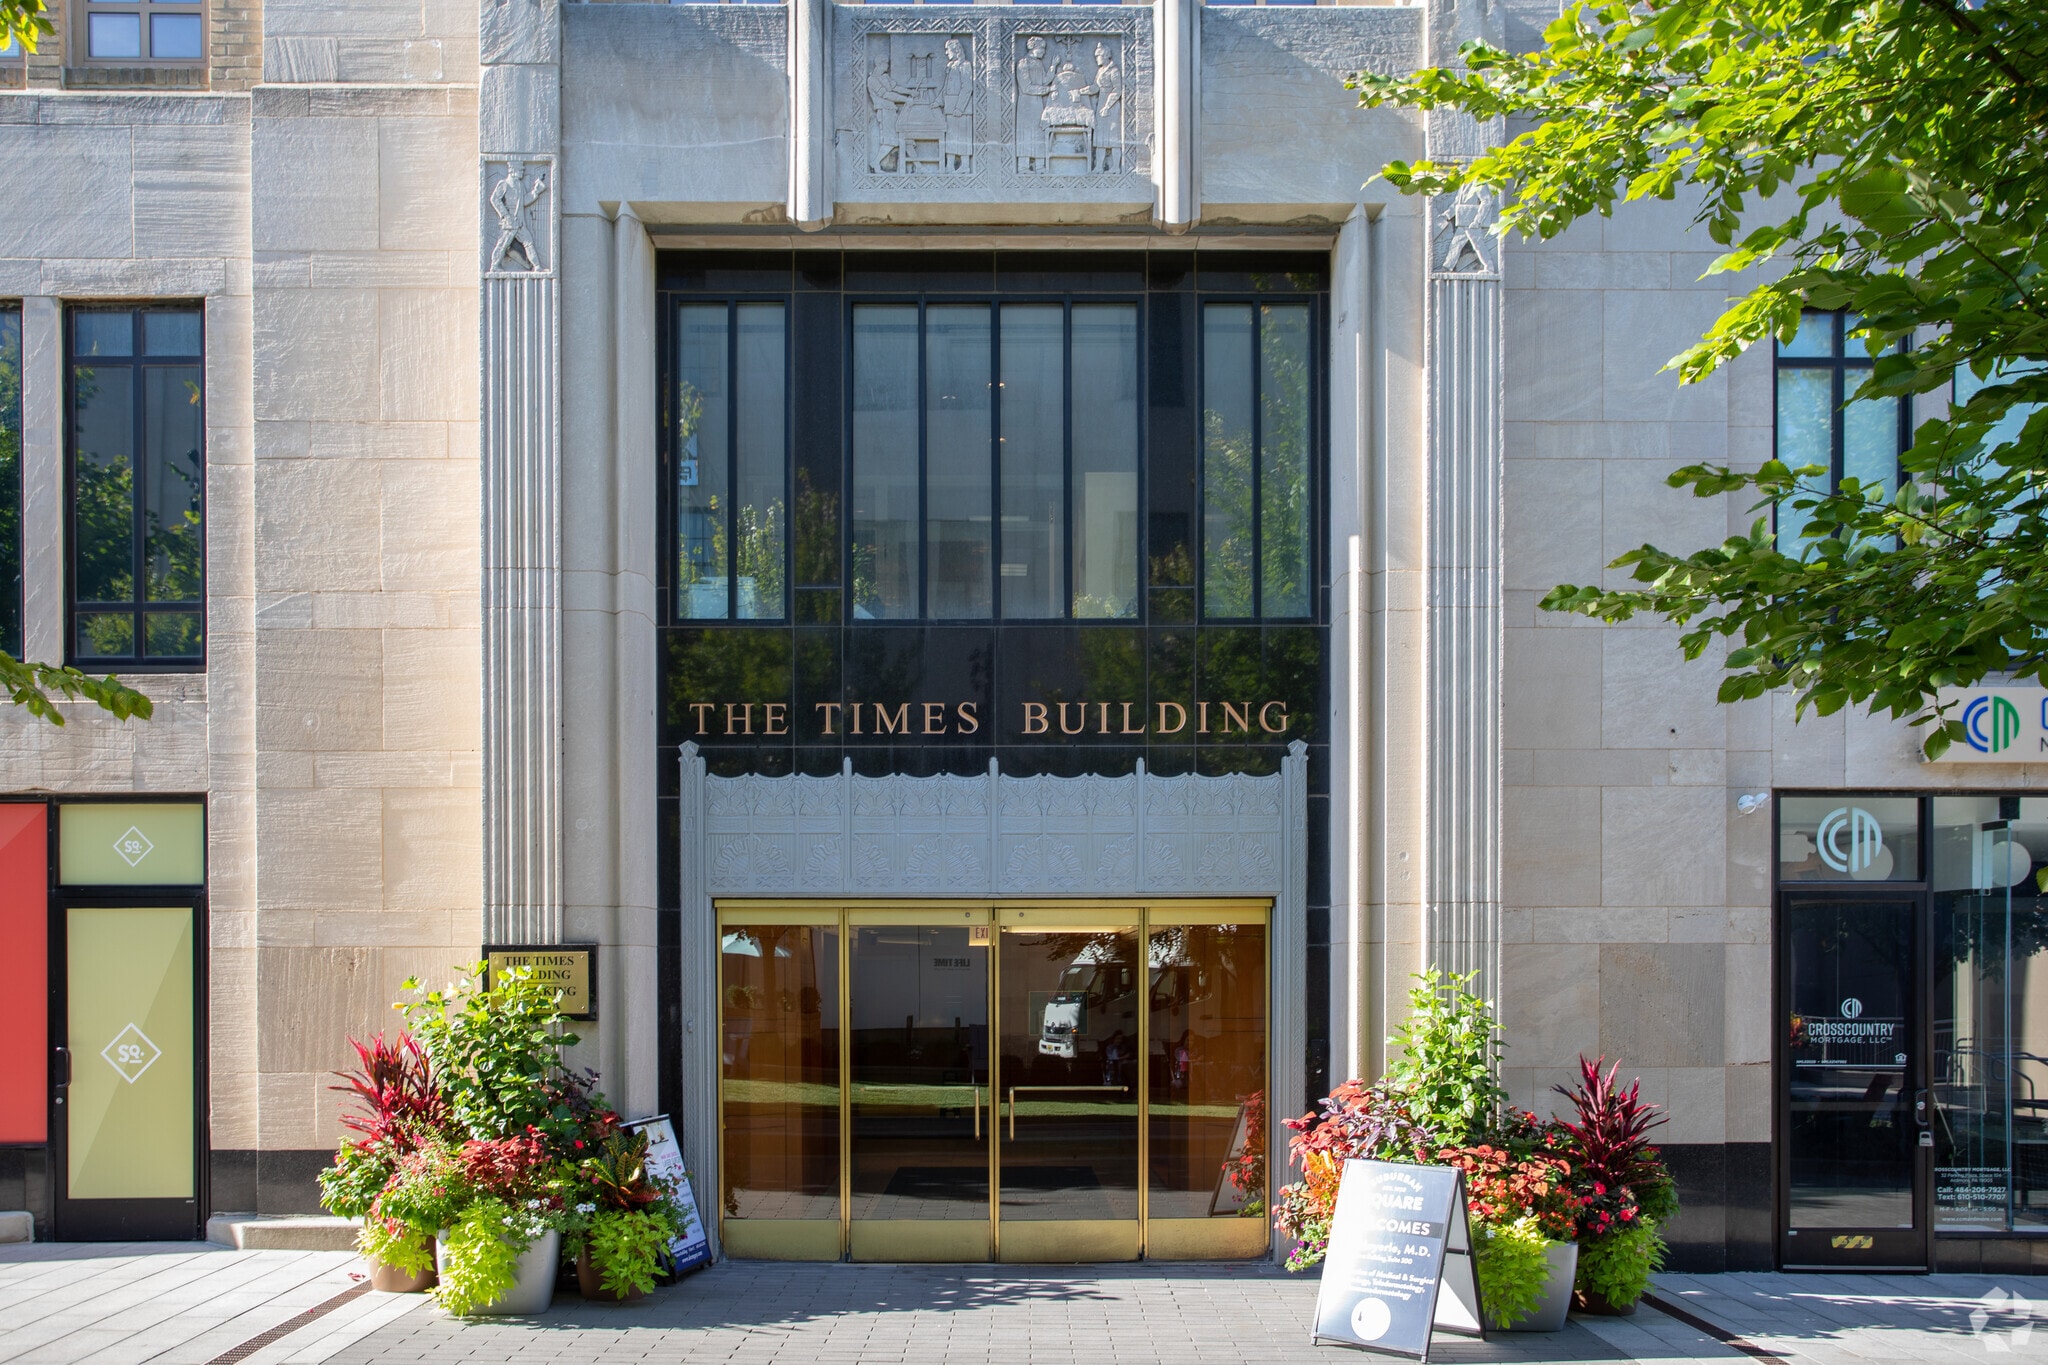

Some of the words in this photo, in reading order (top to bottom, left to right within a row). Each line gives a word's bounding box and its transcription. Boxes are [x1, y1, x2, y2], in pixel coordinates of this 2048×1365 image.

[689, 702, 789, 735] THE
[815, 701, 978, 735] TIMES
[1021, 700, 1290, 735] BUILDING
[975, 927, 989, 939] EXI
[504, 956, 531, 966] THE
[535, 956, 575, 967] TIMES
[528, 970, 571, 980] LDING
[1808, 1023, 1894, 1036] CROSSCOUNTRY
[1373, 1193, 1424, 1212] QUARE
[1376, 1218, 1431, 1237] COMES
[1403, 1244, 1431, 1258] M.D.
[1409, 1274, 1436, 1286] Surgical
